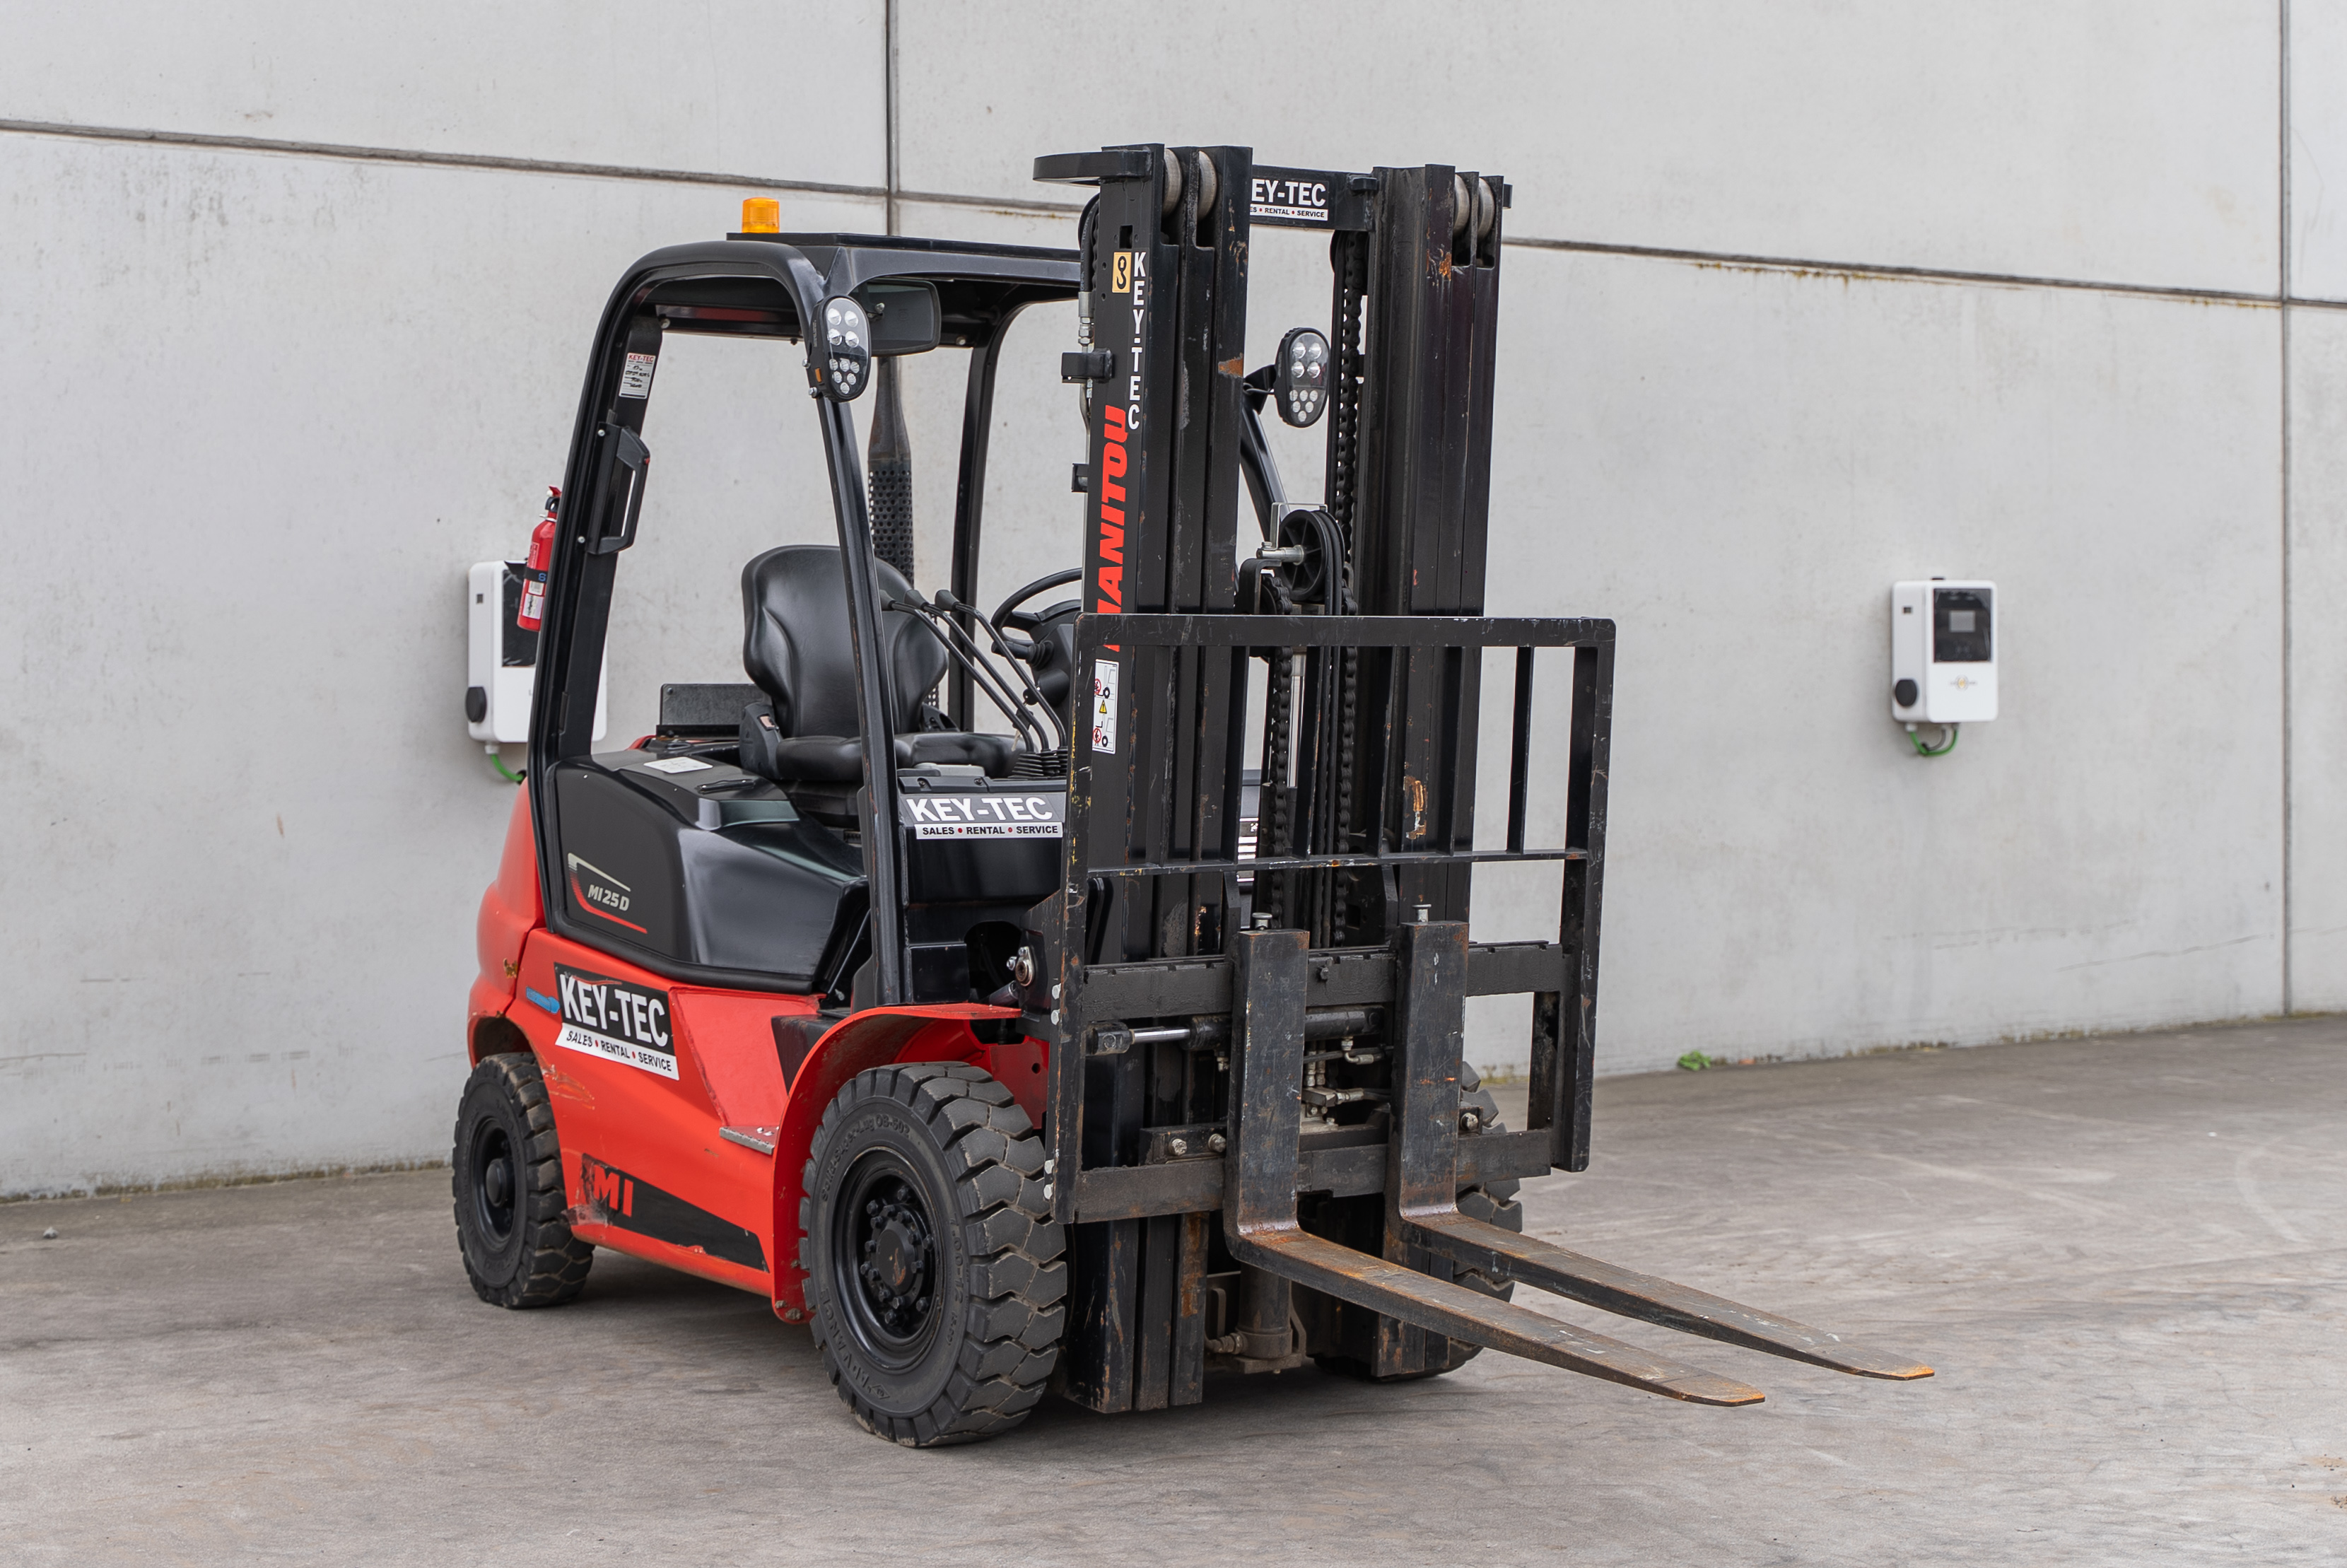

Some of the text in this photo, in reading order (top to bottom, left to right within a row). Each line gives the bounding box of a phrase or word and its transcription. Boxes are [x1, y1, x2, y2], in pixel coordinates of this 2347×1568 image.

[1251, 179, 1326, 207] EY-TEC
[1128, 252, 1146, 430] KEY-TEC
[906, 797, 1053, 821] KEY-TEC
[923, 825, 1058, 835] SALES RENTAL SERVICE
[560, 974, 669, 1047] KEY-TEC
[566, 1031, 672, 1072] SALES RENTAL SERVICE
[593, 1164, 633, 1217] MI
